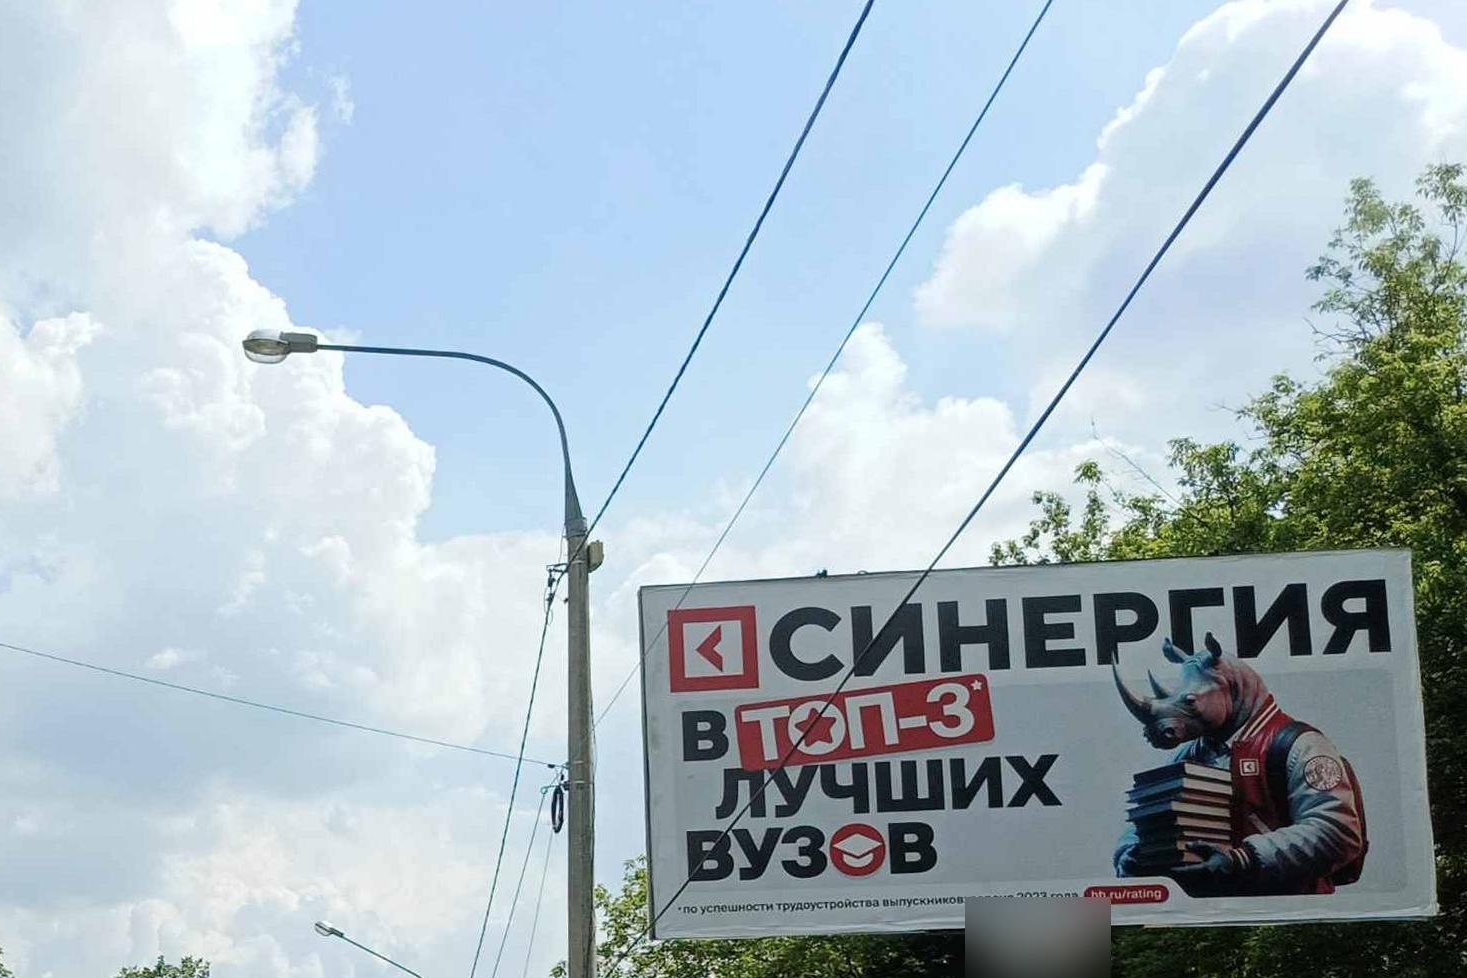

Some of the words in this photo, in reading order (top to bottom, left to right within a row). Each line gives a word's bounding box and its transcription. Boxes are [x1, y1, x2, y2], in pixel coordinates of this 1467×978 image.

[769, 579, 1392, 681] СИНЕРГИЯ
[681, 709, 729, 762] В
[715, 753, 1063, 820] ЛУЧШИХ
[686, 821, 938, 882] ВУЗОВ
[700, 902, 774, 915] успешности
[775, 898, 880, 912] трудоустройства
[1090, 888, 1163, 901] hhru/rating
